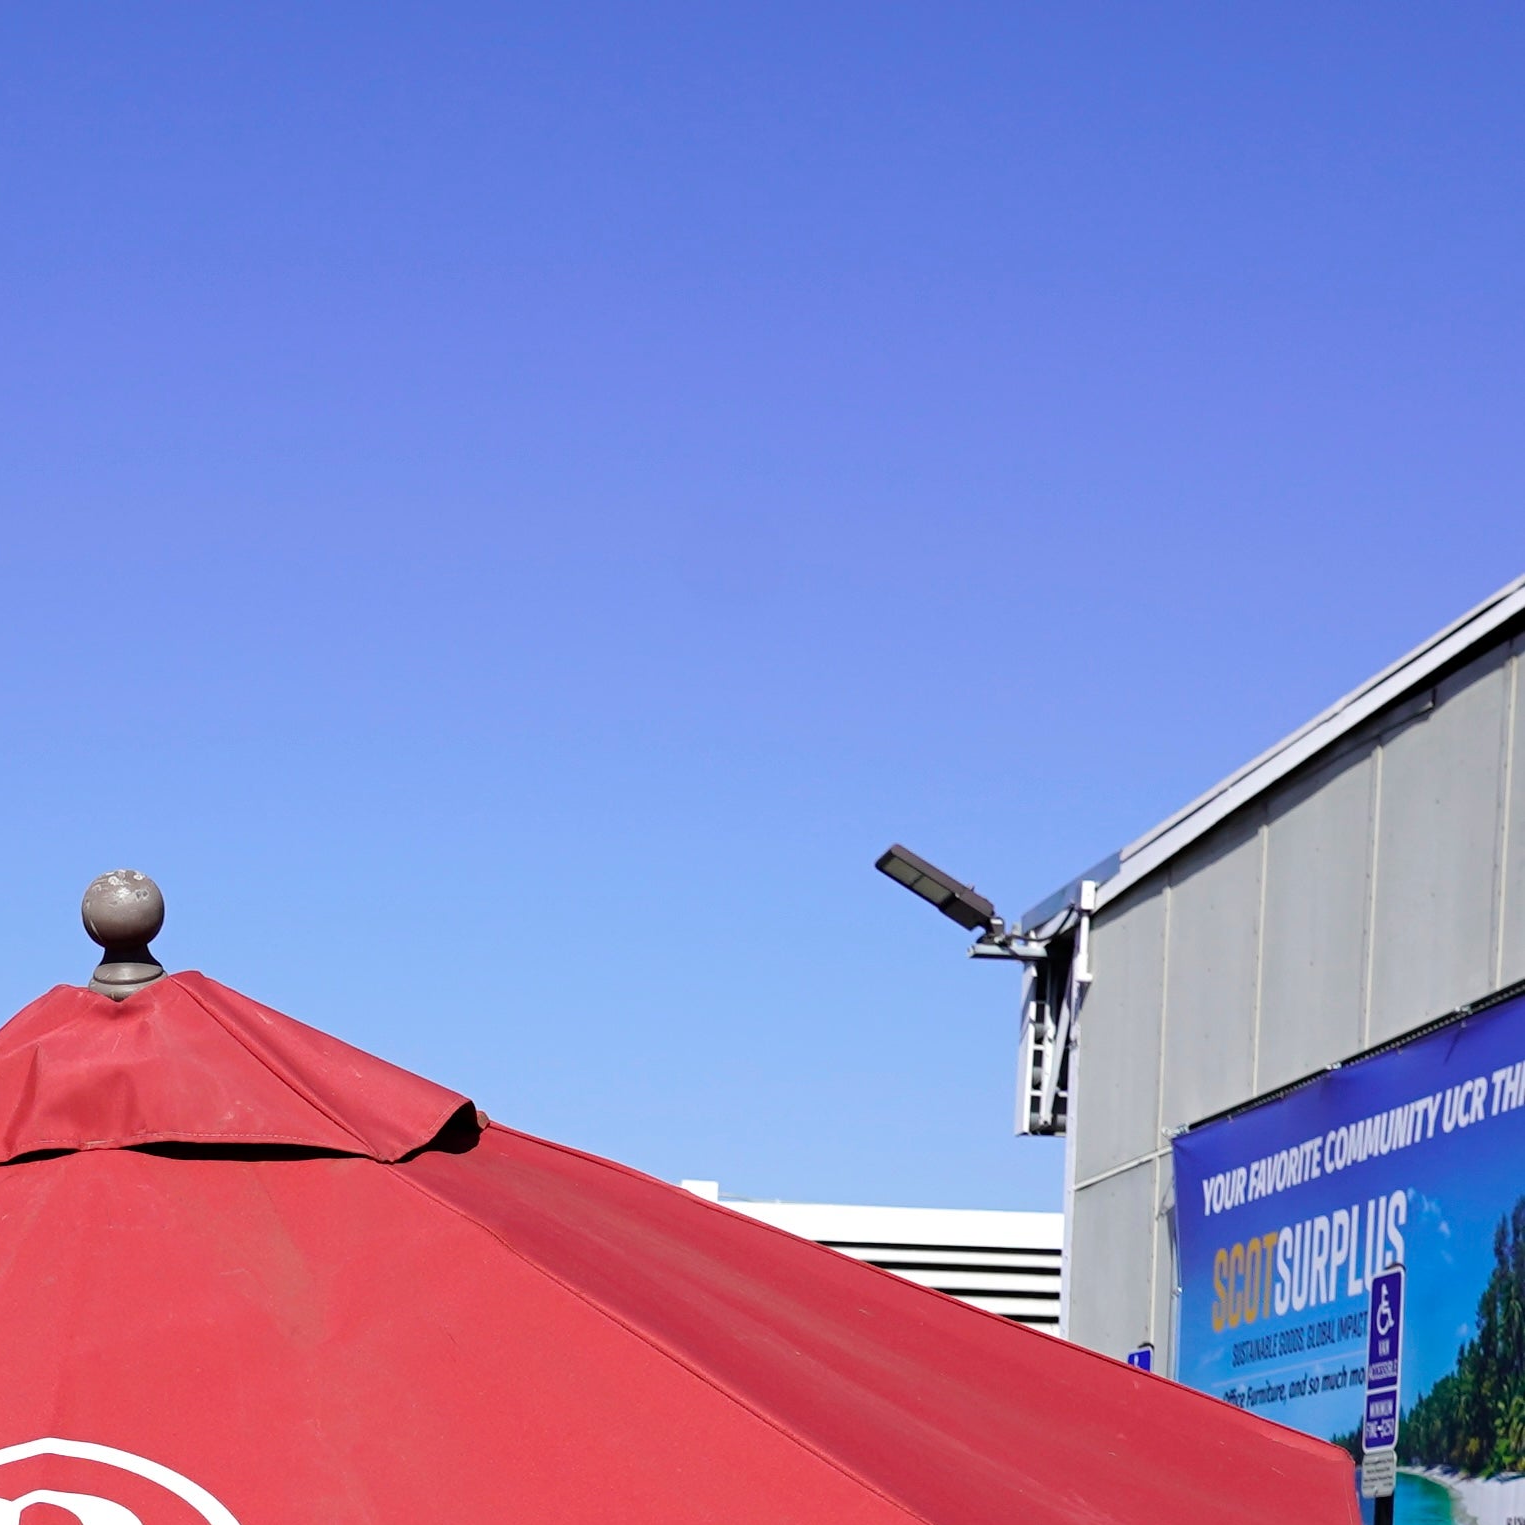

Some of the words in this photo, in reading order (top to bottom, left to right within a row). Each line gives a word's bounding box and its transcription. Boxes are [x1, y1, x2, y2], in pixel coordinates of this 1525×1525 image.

[1202, 1166, 1247, 1216] YOUR
[1247, 1136, 1323, 1201] FAVORITE
[1324, 1092, 1443, 1175] COMMUNITY
[1442, 1076, 1488, 1133] UCR
[1232, 1333, 1278, 1368] SUSTAINABLE
[1289, 1372, 1308, 1399] and
[1308, 1376, 1320, 1395] so
[1321, 1364, 1348, 1391] much
[1349, 1367, 1366, 1387] mo
